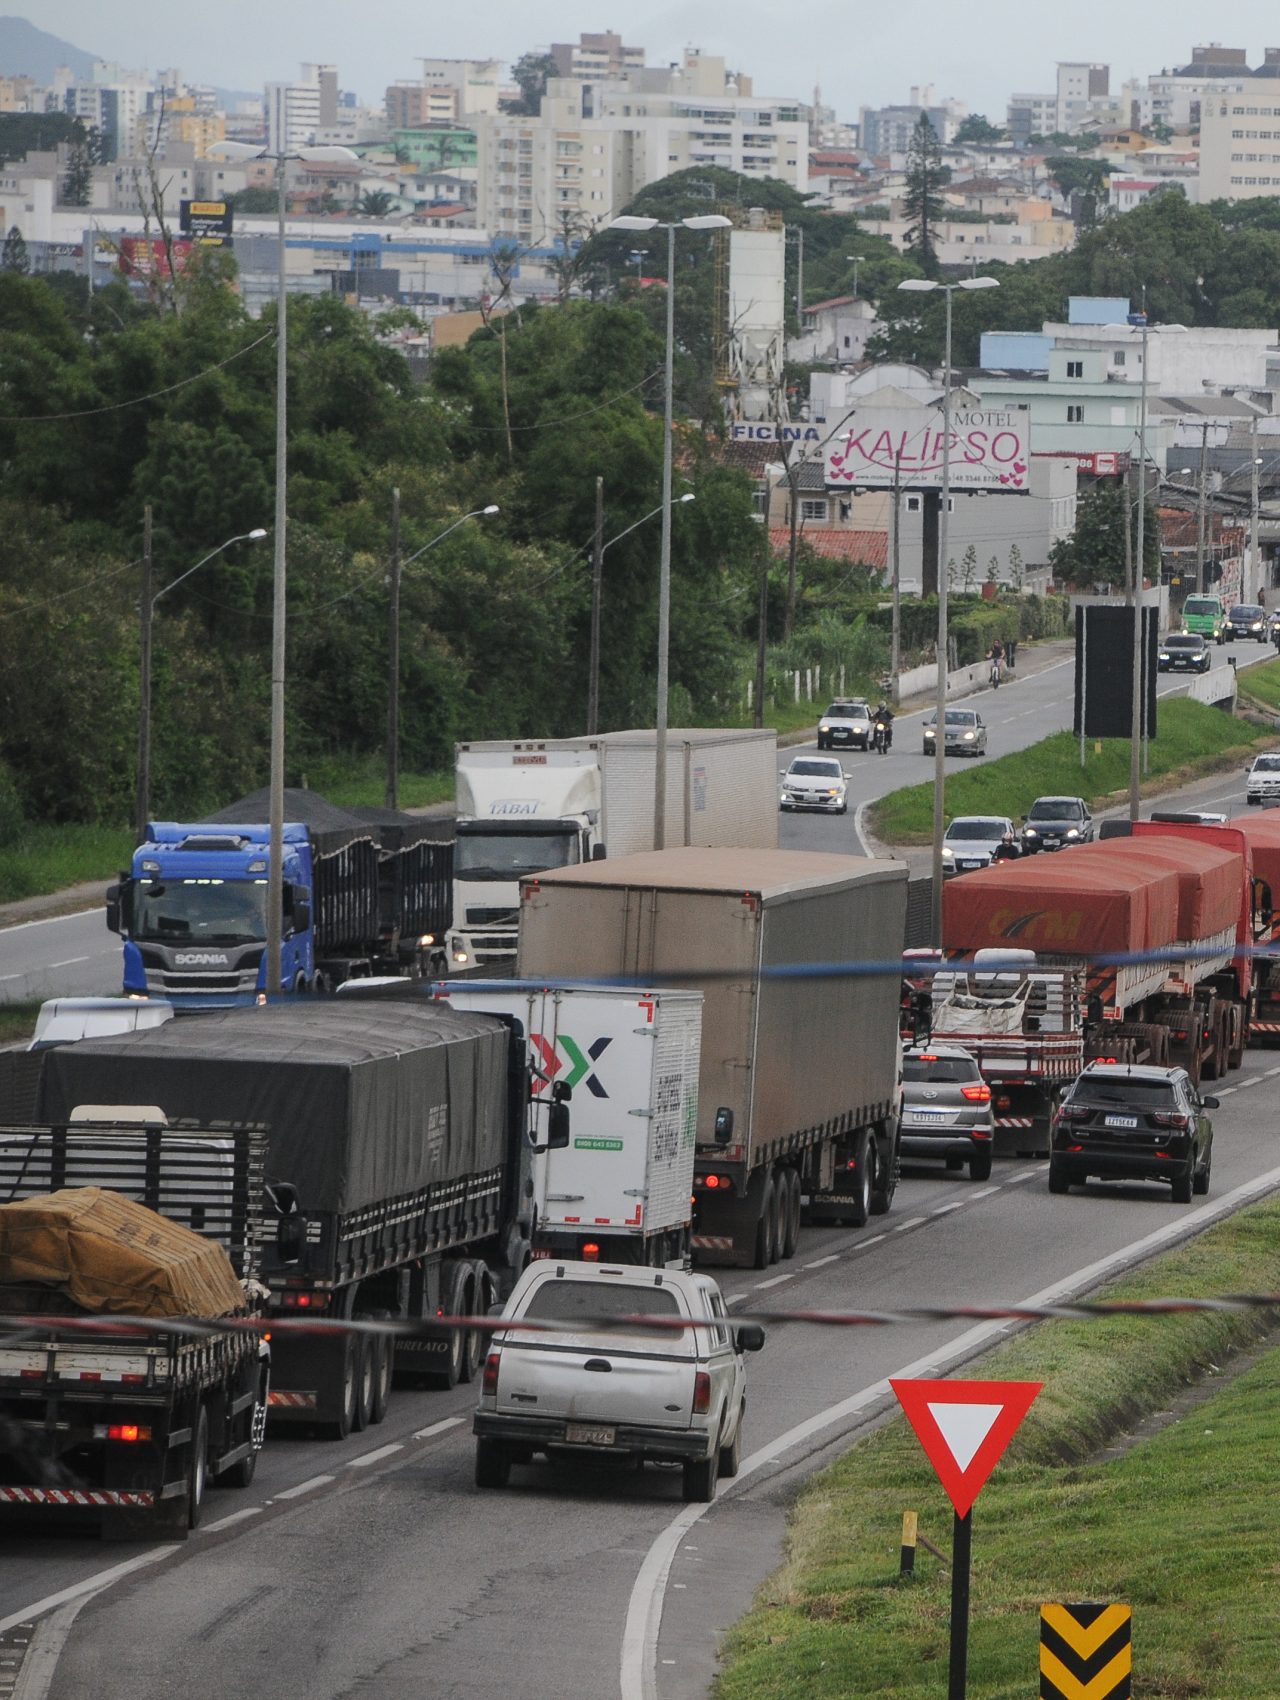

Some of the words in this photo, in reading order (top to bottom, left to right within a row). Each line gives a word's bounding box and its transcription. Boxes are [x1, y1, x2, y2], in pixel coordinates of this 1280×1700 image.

[953, 411, 1017, 427] MOTEL
[731, 424, 820, 441] FICINA
[175, 953, 228, 965] SCANIA
[814, 1194, 855, 1204] SCANIA
